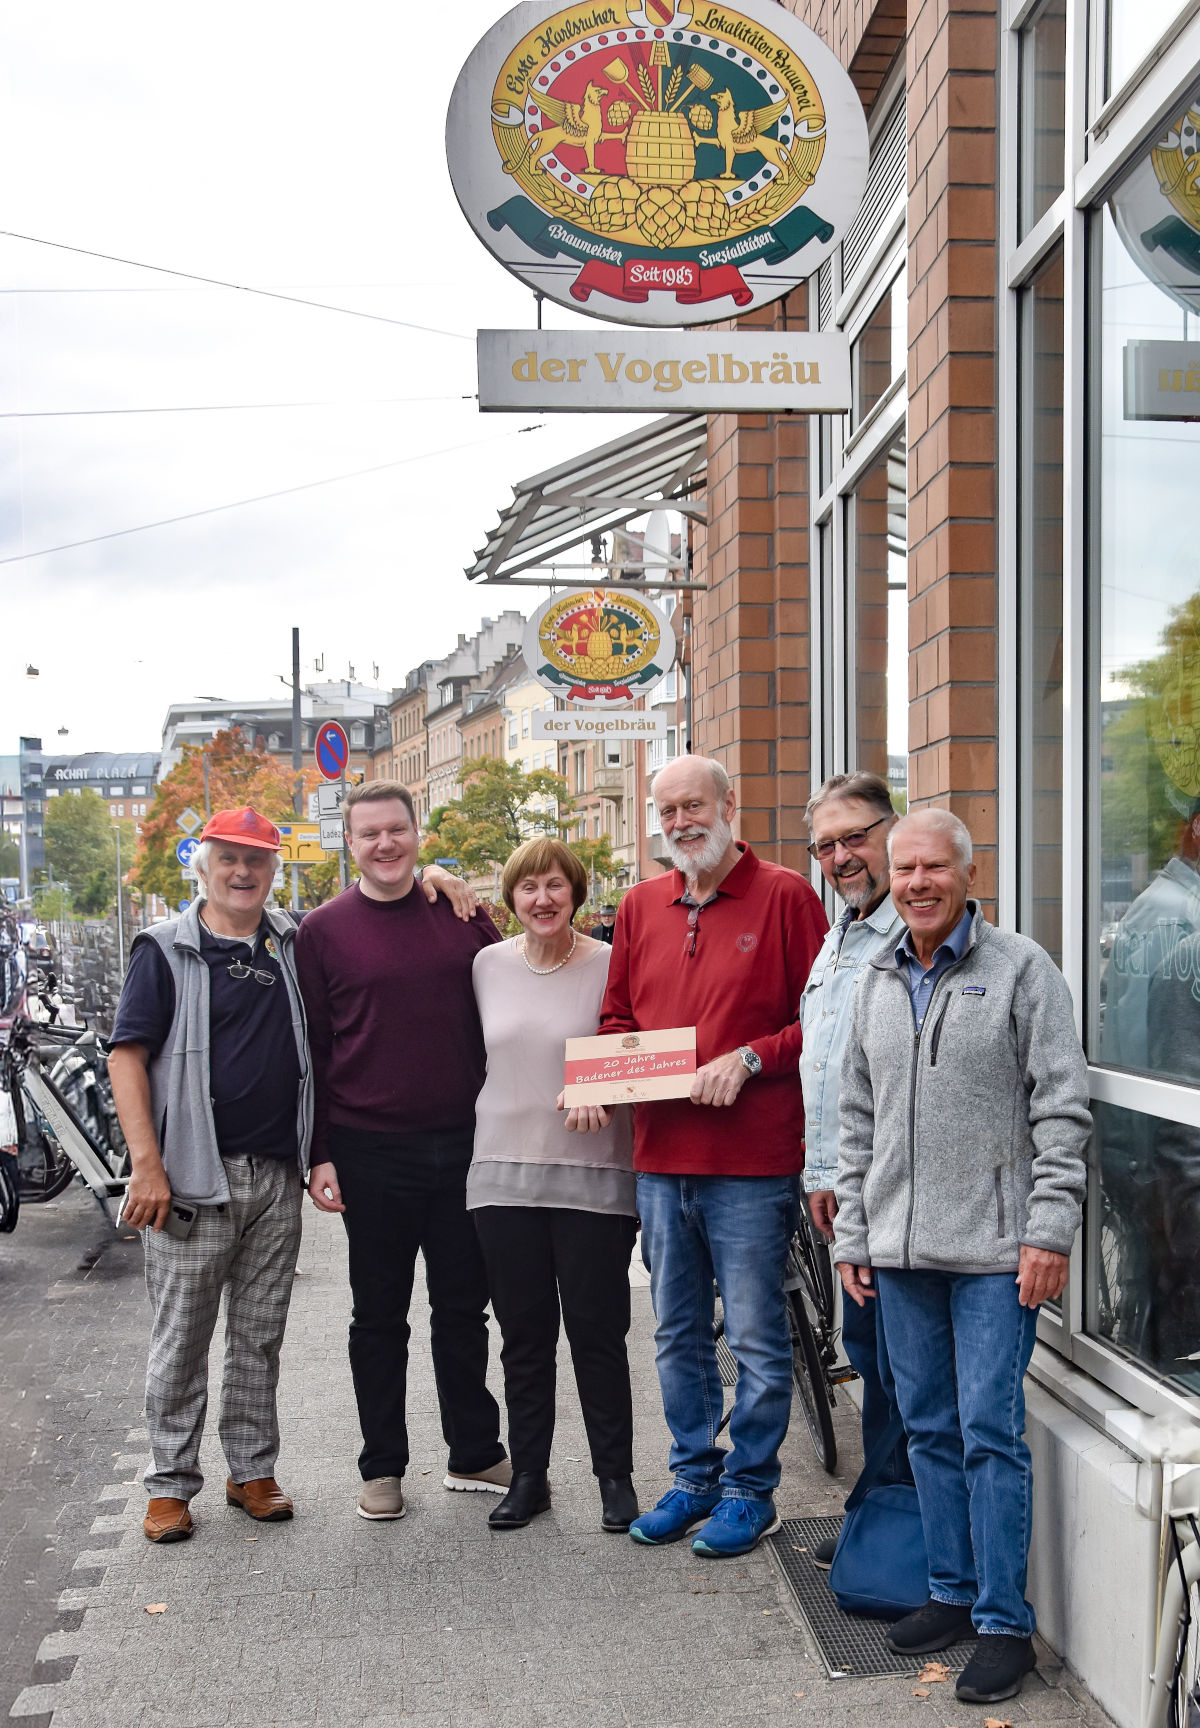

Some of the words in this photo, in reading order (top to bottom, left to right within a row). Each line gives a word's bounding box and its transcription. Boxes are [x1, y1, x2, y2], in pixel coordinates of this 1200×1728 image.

[506, 54, 538, 95] Erste
[534, 8, 621, 57] Karlsruher
[695, 8, 774, 59] Lokalitäten
[771, 49, 816, 112] Brauerei
[549, 224, 623, 266] Braumeister
[699, 230, 776, 267] Spezialitäten
[630, 265, 660, 283] Seit
[661, 267, 693, 286] 1985
[511, 351, 587, 382] der
[595, 352, 822, 393] Vogelbräu
[543, 719, 570, 731] der
[574, 718, 657, 734] Vogelbräu
[54, 767, 89, 780] ACHAT
[96, 766, 137, 779] PLAZA
[575, 1069, 623, 1084] Badener
[627, 1065, 645, 1075] des
[650, 1057, 687, 1071] Jahres
[603, 1060, 620, 1069] 20
[624, 1054, 656, 1066] Jahre
